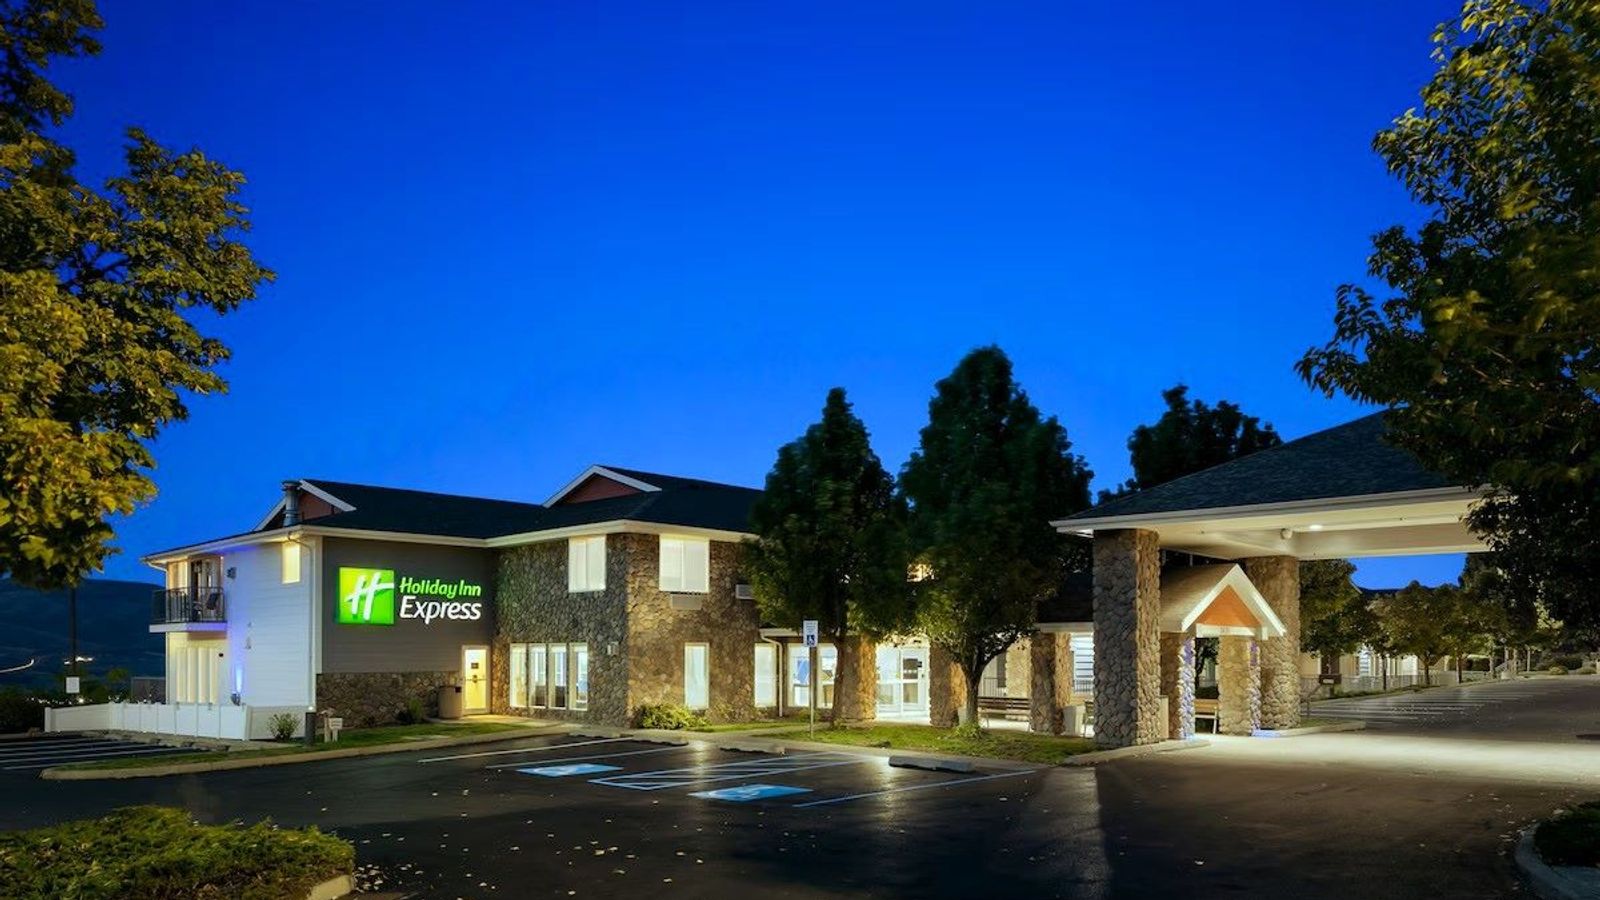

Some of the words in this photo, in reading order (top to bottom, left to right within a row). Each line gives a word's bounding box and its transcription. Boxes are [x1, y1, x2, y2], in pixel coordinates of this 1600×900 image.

[400, 577, 458, 598] Holiday
[459, 580, 481, 596] Inn
[400, 595, 482, 624] Express
